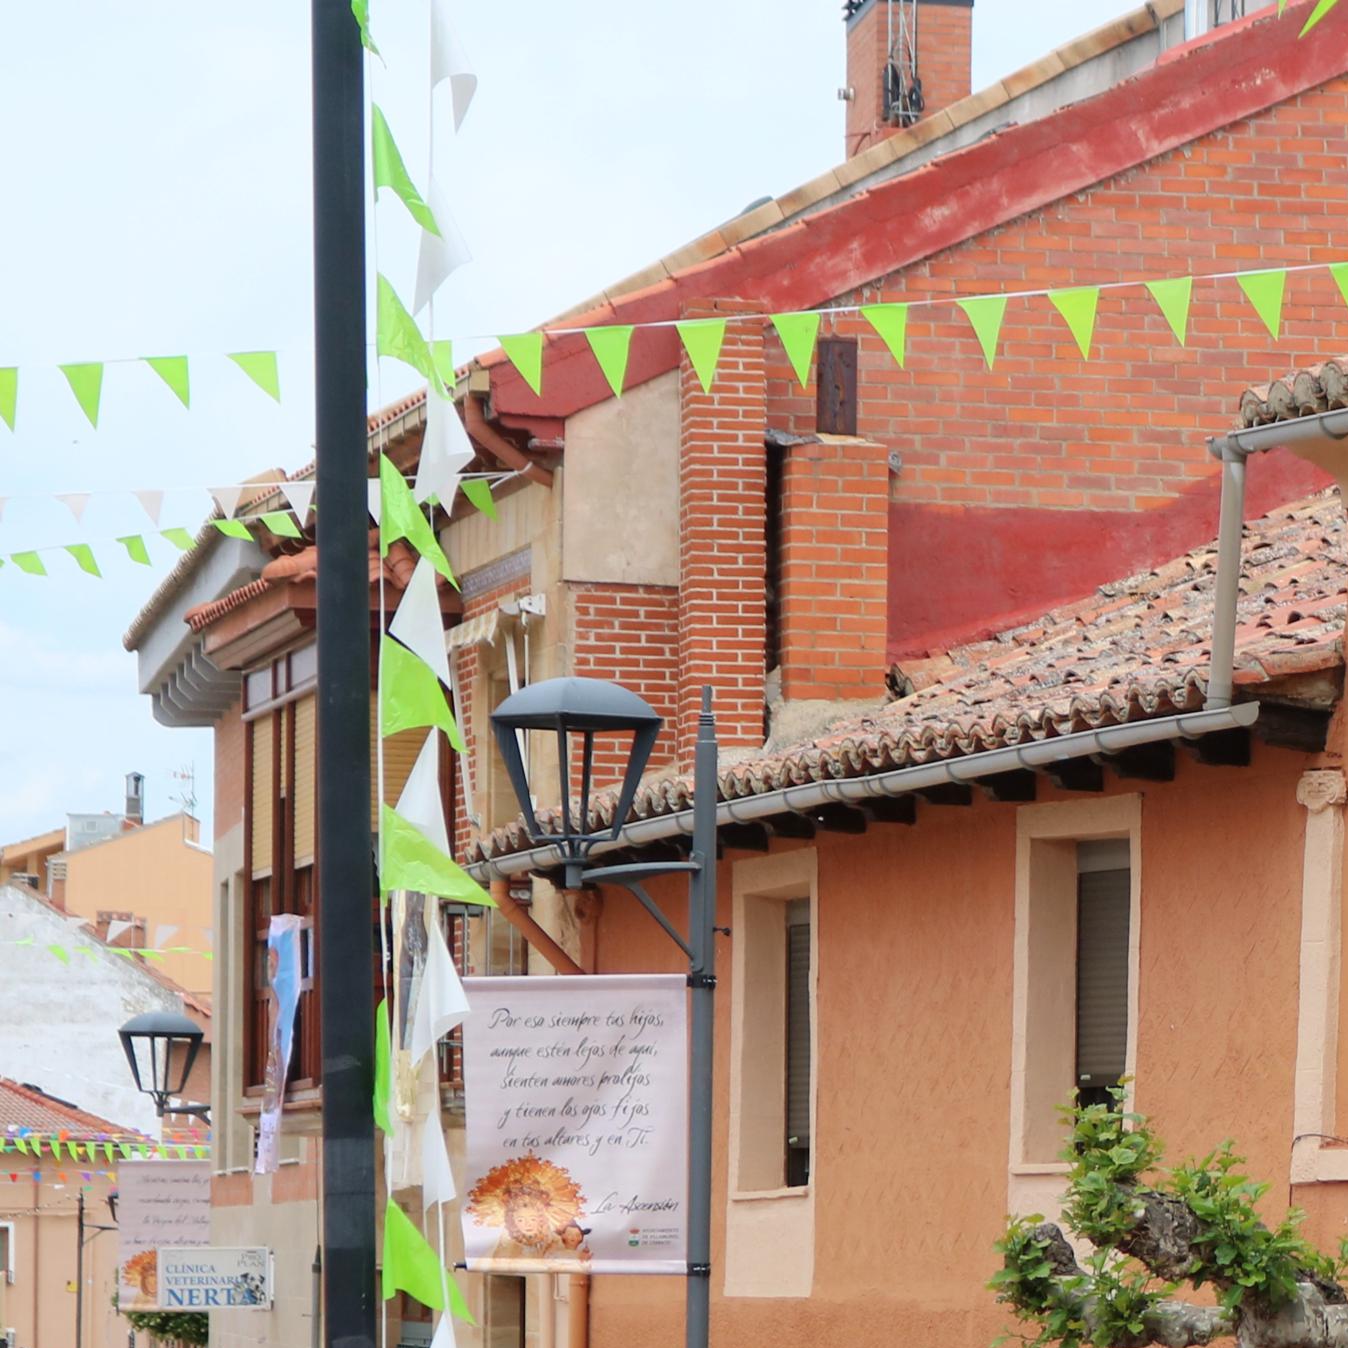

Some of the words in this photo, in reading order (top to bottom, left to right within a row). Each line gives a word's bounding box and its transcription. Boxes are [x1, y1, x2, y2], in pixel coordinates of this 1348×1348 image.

[488, 1008, 521, 1029] Por
[524, 1016, 545, 1028] eso
[549, 1012, 600, 1032] siempre
[606, 1011, 624, 1026] tus
[629, 1006, 663, 1039] hijos,
[490, 1046, 530, 1074] aunque
[575, 1036, 605, 1071] lejos
[609, 1035, 627, 1059] de
[502, 1070, 548, 1089] sienten
[552, 1074, 595, 1088] amores
[497, 1106, 511, 1129] y
[515, 1102, 556, 1118] tienen
[560, 1097, 577, 1117] los
[576, 1102, 606, 1130] ojos
[610, 1096, 649, 1130] fijos
[503, 1136, 517, 1147] en
[522, 1133, 540, 1147] tus
[608, 1135, 623, 1146] en
[590, 1191, 617, 1214] La
[165, 1262, 216, 1274] CLÍNICA
